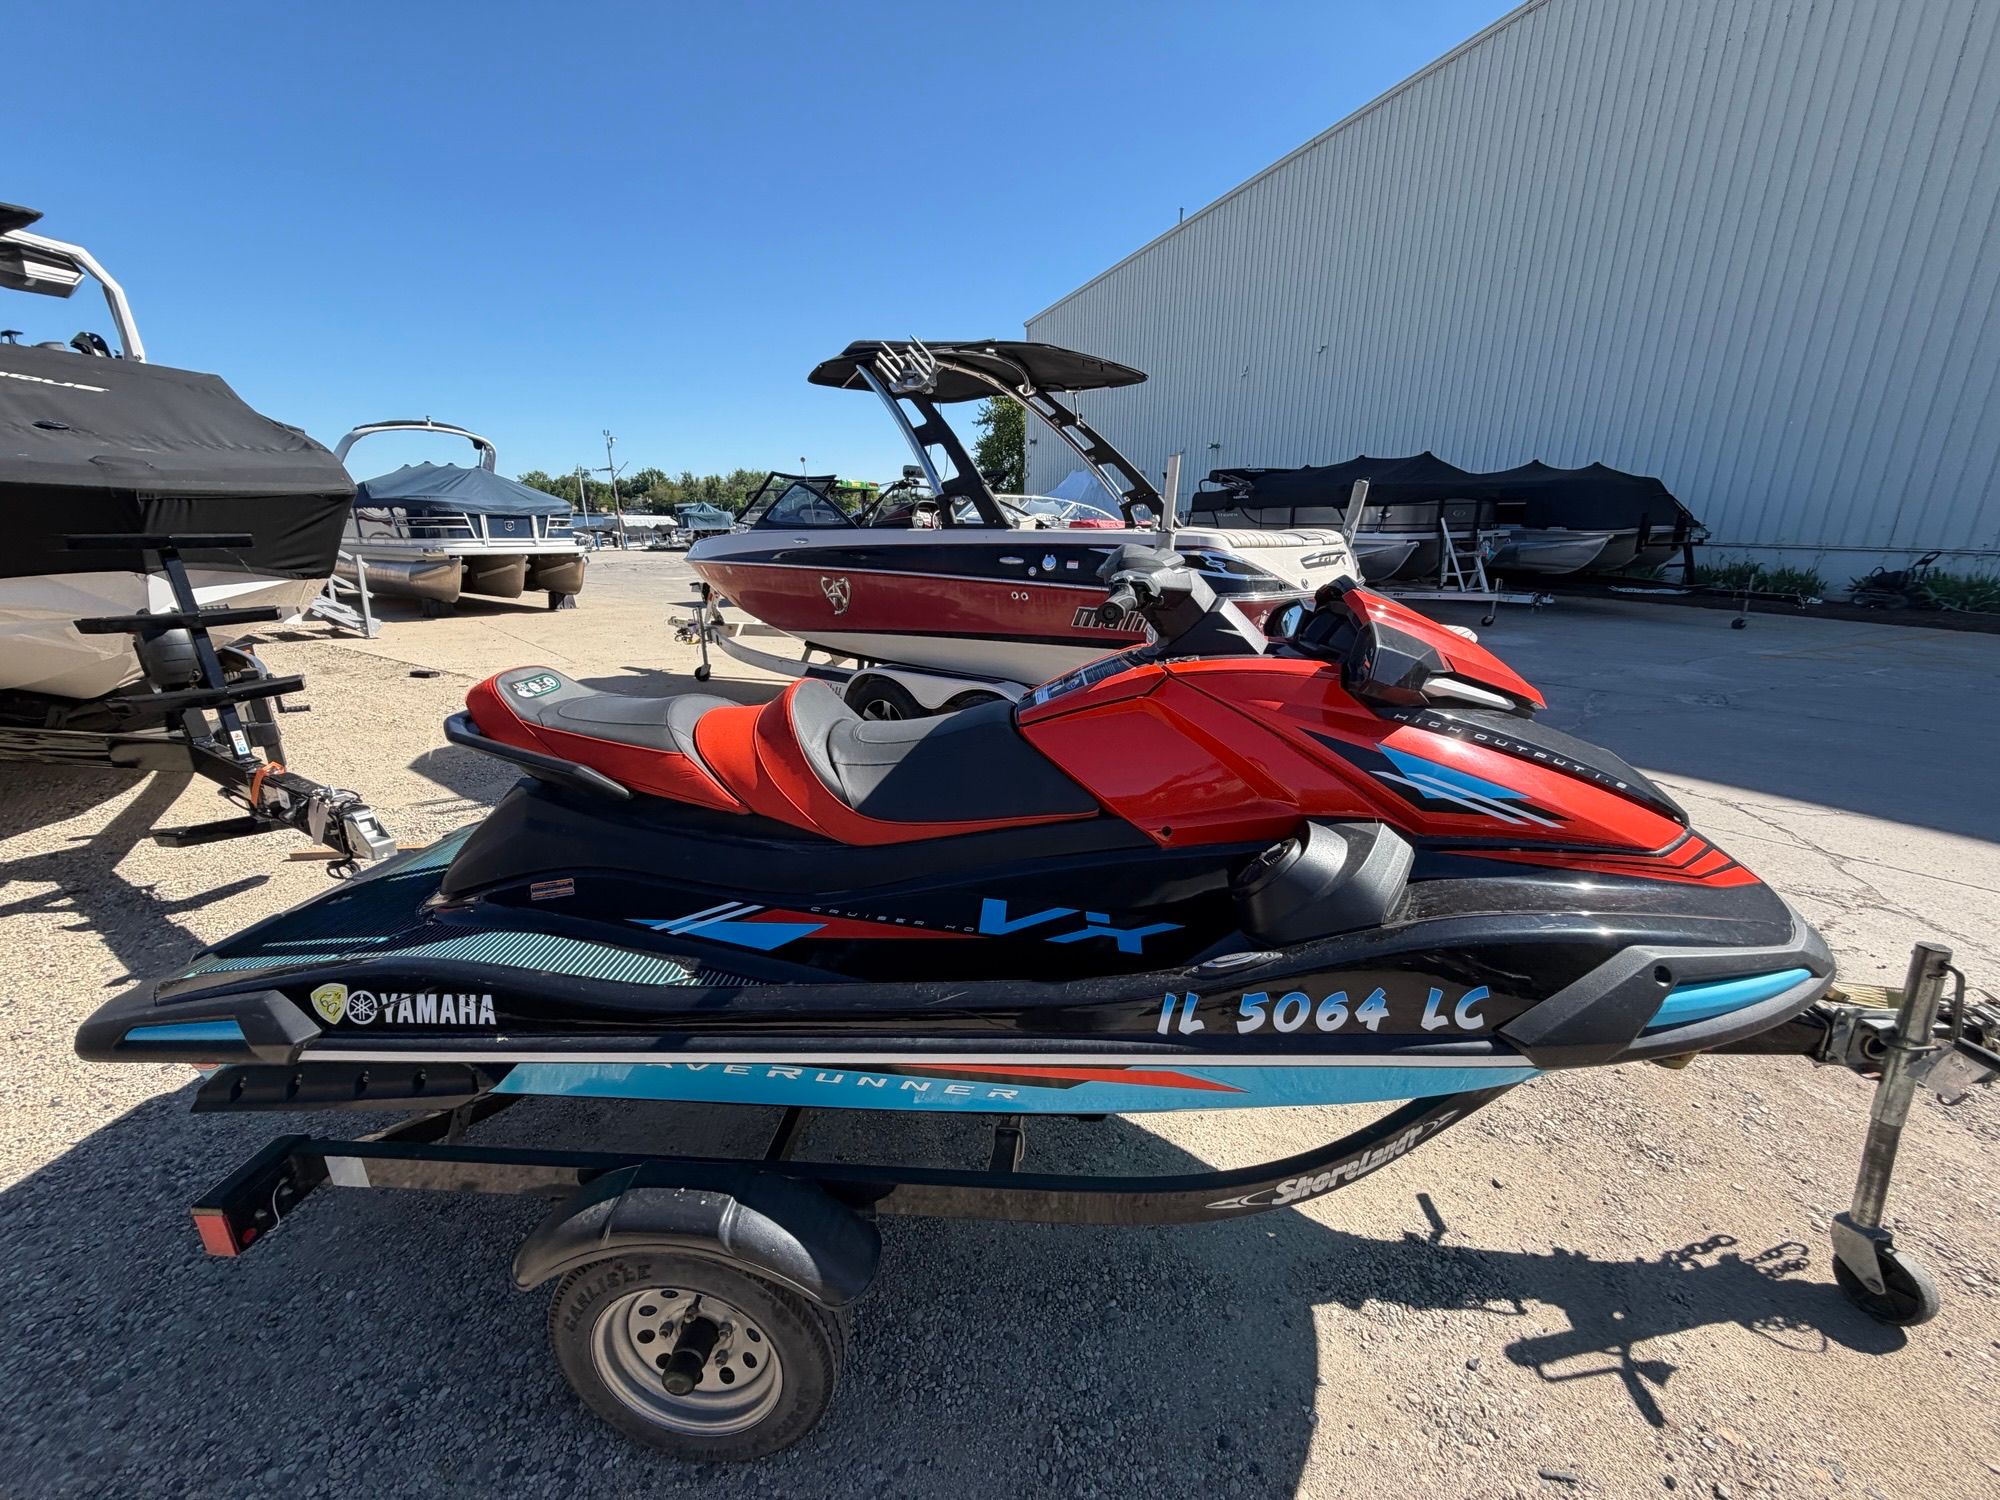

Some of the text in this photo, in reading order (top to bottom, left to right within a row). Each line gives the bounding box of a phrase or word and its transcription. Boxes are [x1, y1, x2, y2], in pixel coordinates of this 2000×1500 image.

[1394, 713, 1462, 734] HIGH
[1474, 733, 1585, 772] OUTPUT
[810, 905, 975, 933] CRUISER HO
[379, 992, 498, 1026] YAMAHA
[1156, 985, 1491, 1036] IL 5064 LC
